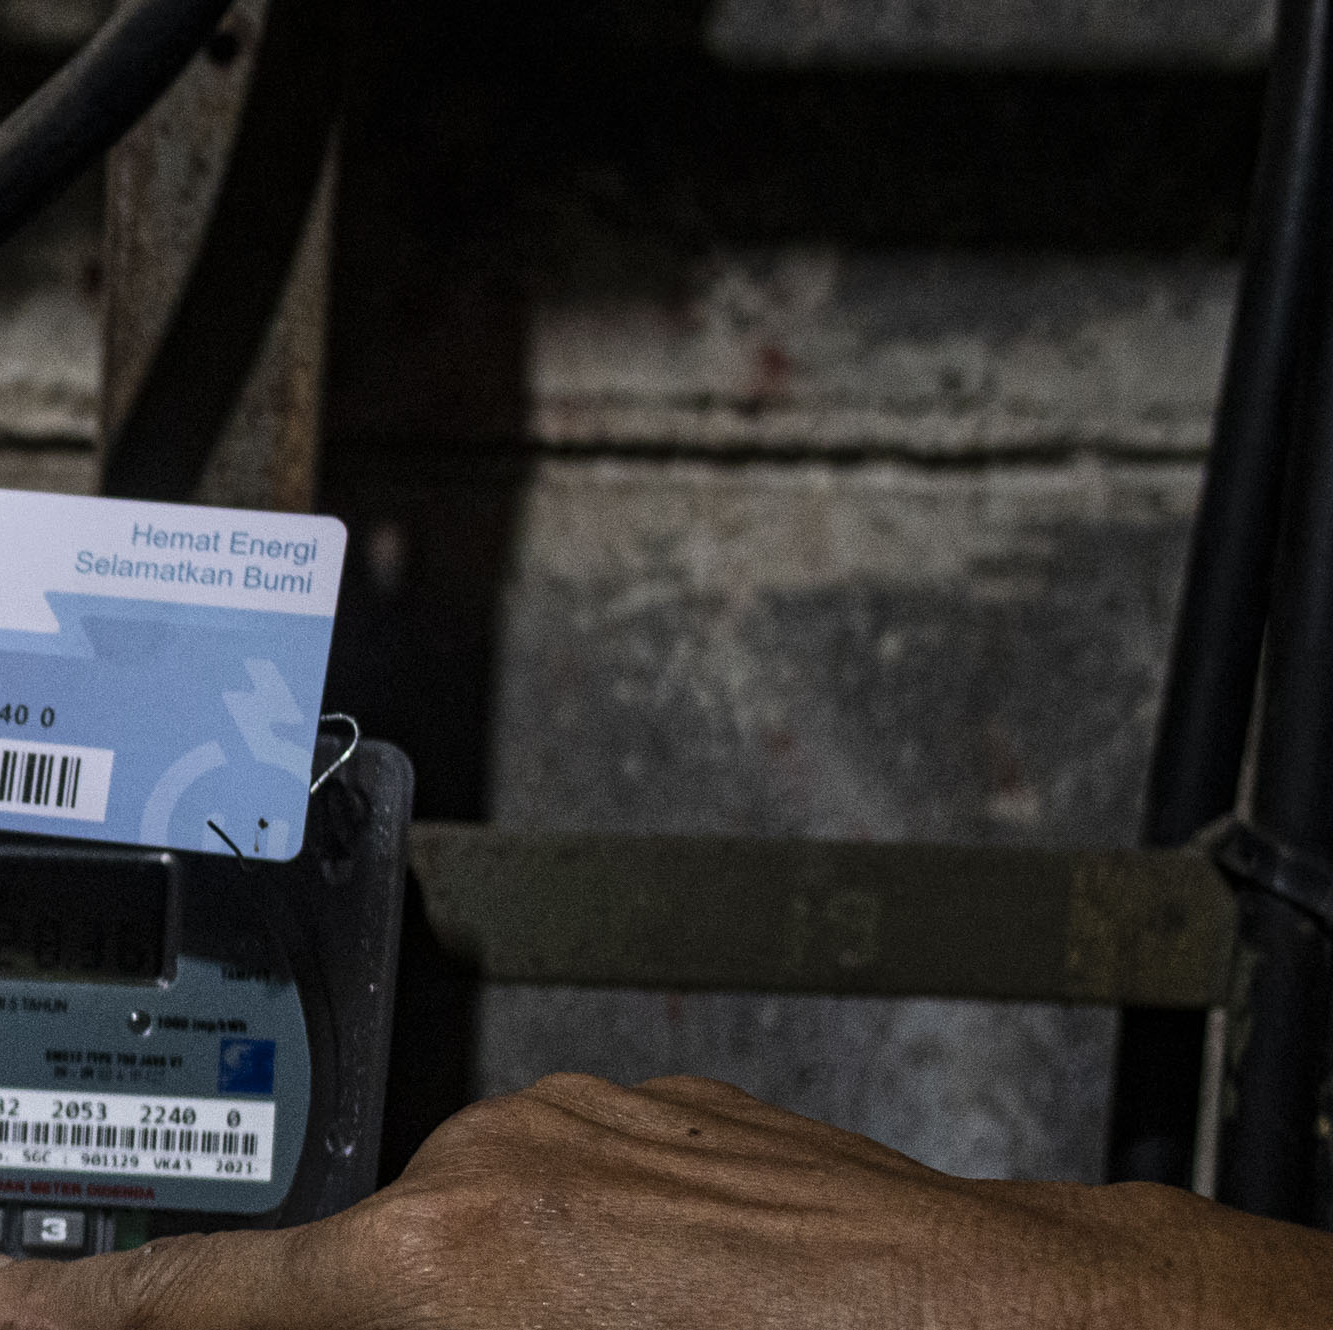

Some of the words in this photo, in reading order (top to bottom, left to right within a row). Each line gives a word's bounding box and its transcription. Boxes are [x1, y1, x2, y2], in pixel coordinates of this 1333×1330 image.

[131, 522, 221, 553] Hemat
[229, 531, 318, 566] Energi
[74, 550, 233, 588] Selamatkan
[243, 565, 313, 594] Bumi
[40, 706, 56, 729] 0
[51, 1100, 108, 1121] 2053
[140, 1105, 197, 1126] 2240
[226, 1110, 242, 1128] 0
[40, 1216, 68, 1242] 3
